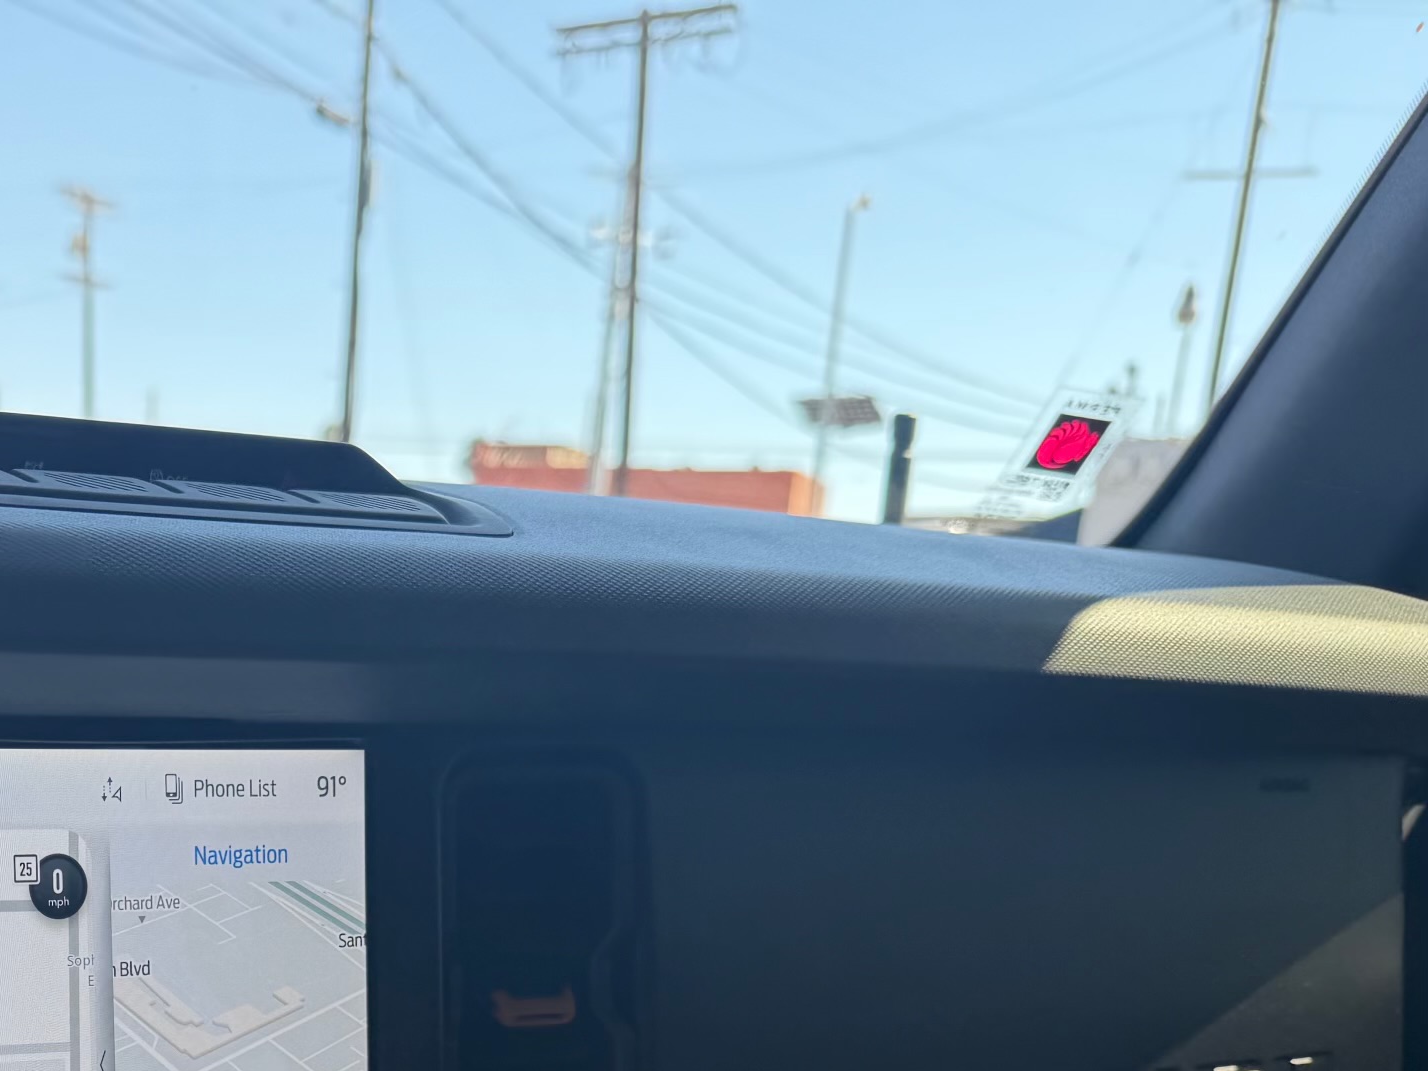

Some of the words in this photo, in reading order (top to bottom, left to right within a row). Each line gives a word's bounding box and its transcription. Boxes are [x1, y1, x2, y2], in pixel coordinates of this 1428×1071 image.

[194, 779, 245, 798] Phone
[249, 779, 277, 798] List
[317, 775, 347, 798] 91°
[194, 845, 288, 869] Navigation
[19, 862, 33, 877] 25
[52, 868, 64, 894] 0
[48, 896, 70, 909] mph
[112, 896, 153, 911] rchard
[157, 895, 181, 910] Ave
[338, 933, 366, 948] San
[120, 960, 150, 977] Blvd
